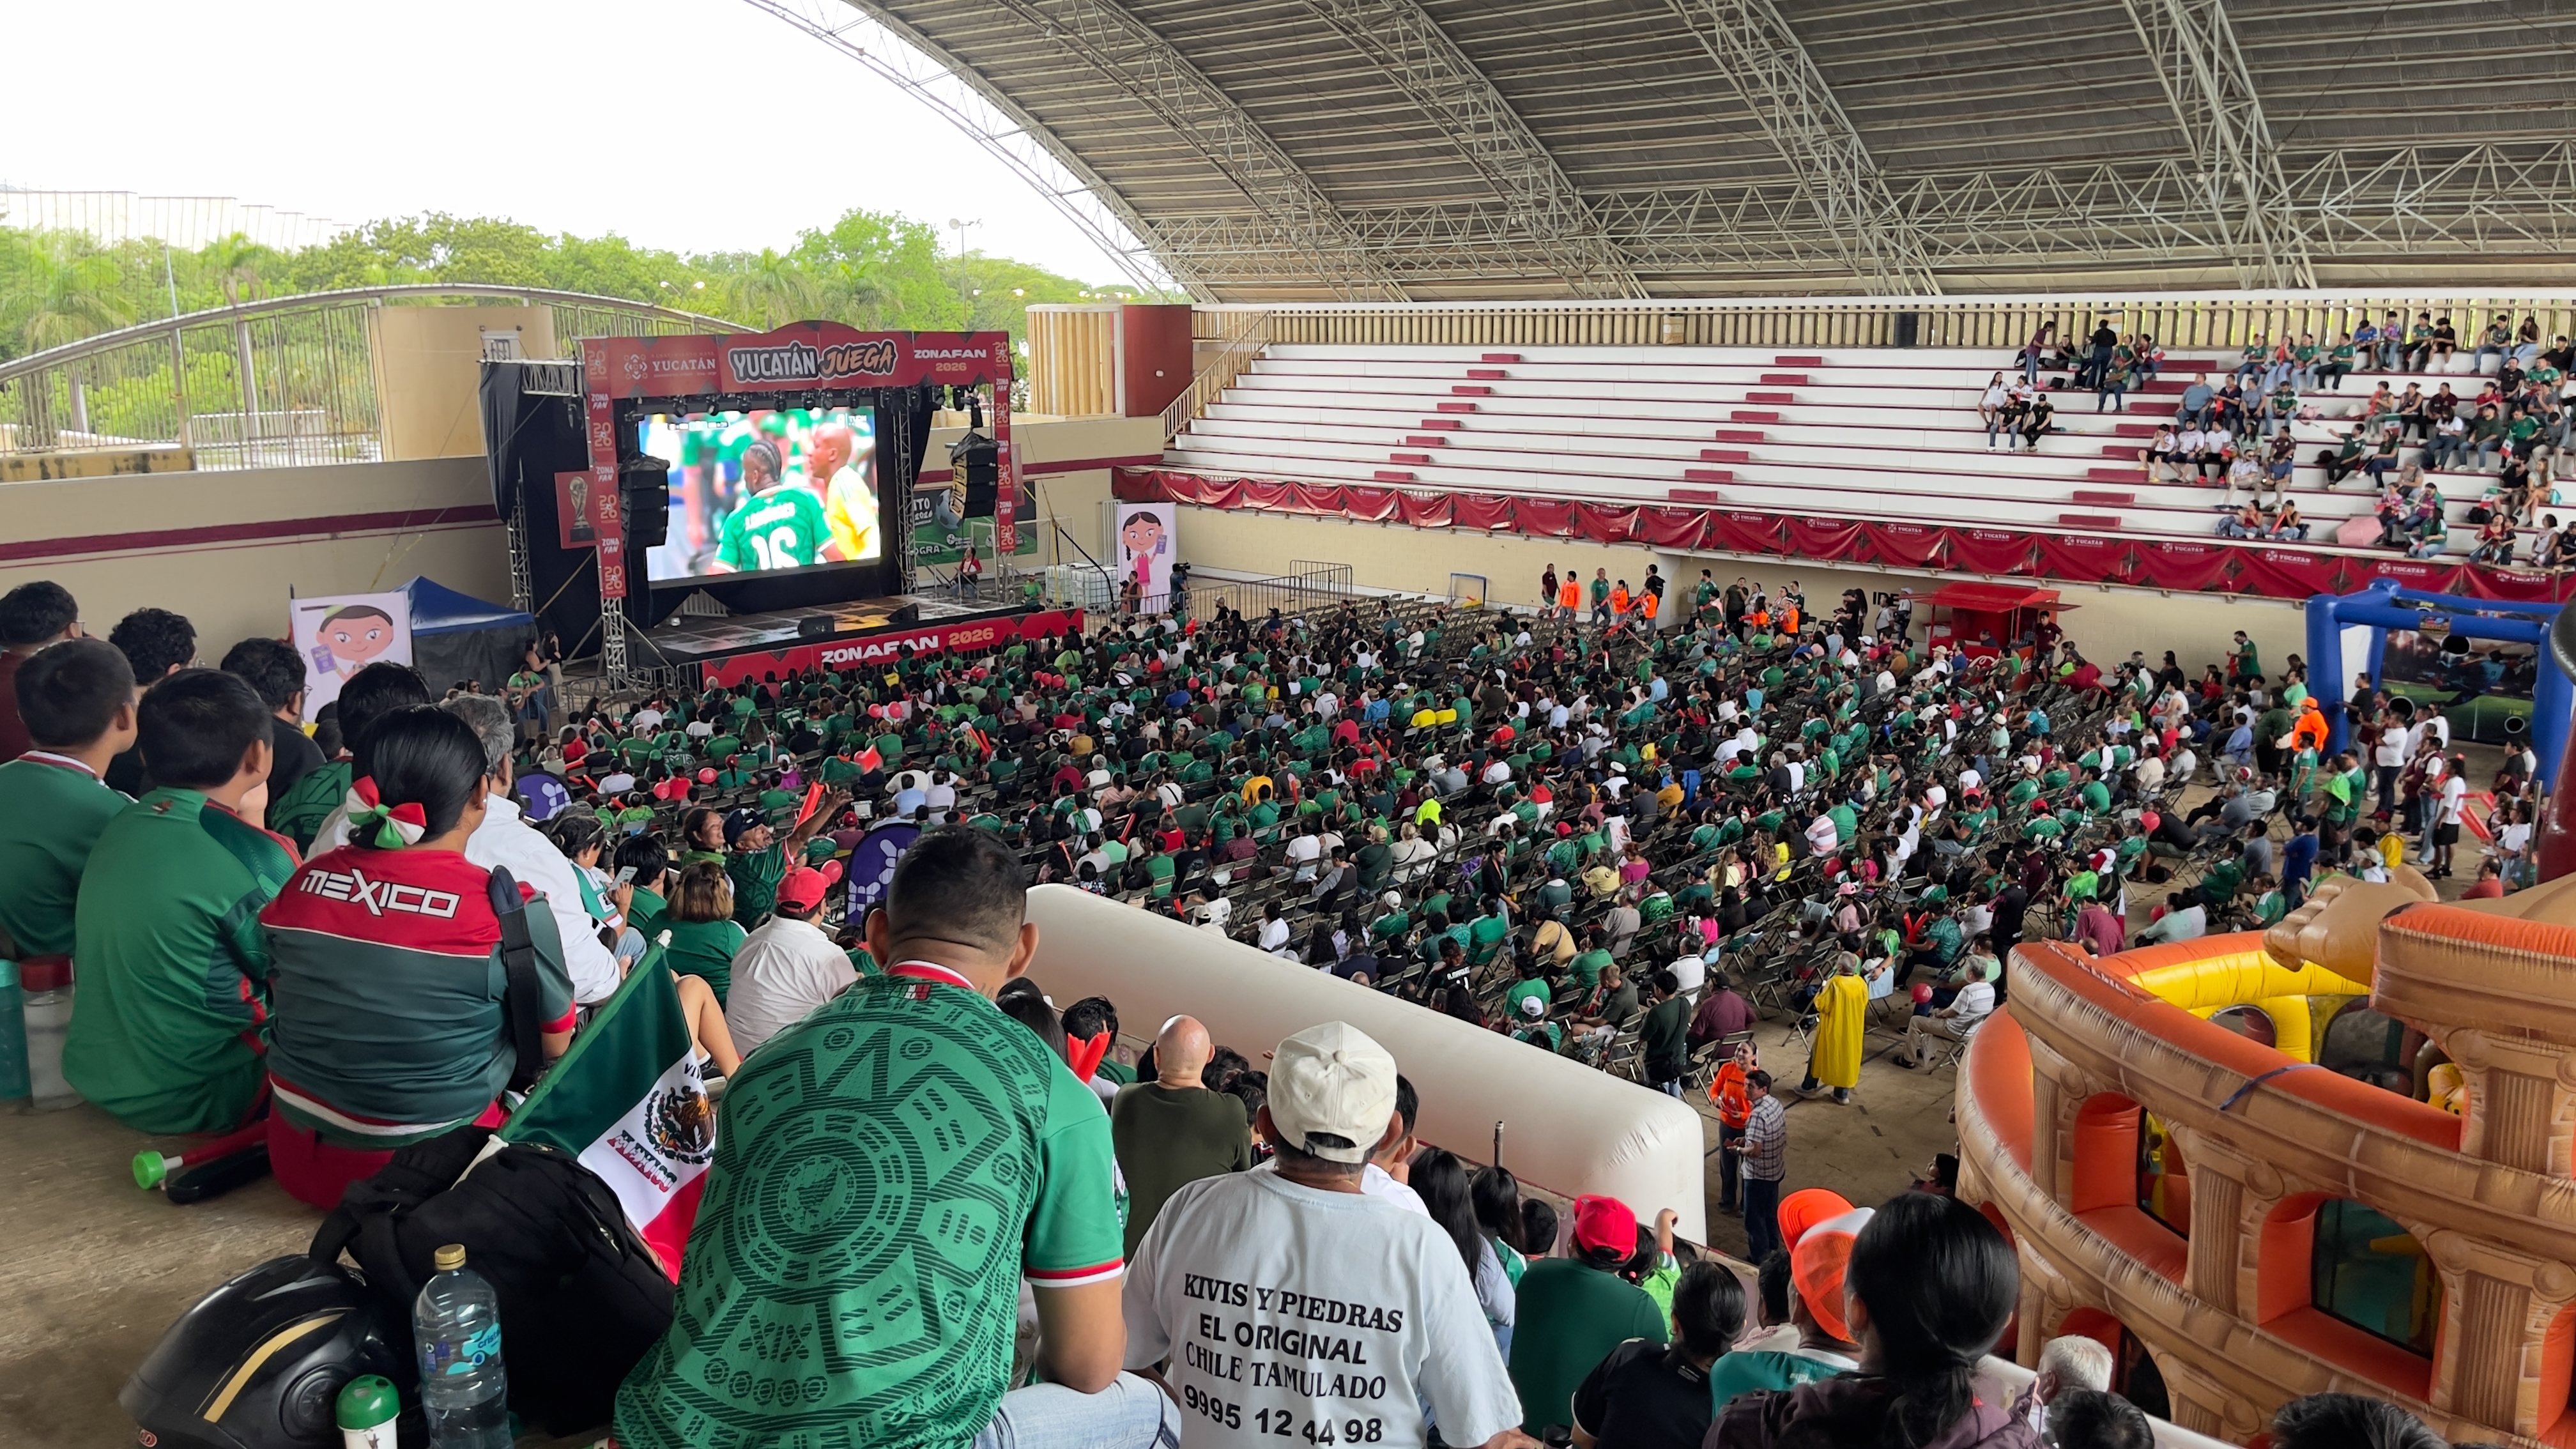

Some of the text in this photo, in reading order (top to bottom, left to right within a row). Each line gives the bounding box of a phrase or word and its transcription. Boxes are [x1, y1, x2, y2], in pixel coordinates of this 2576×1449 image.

[652, 357, 716, 371] YUCATÁN
[733, 344, 893, 378] YUCATÁN JUEGA
[914, 349, 986, 359] ZONAFAN
[935, 362, 967, 372] 2026
[591, 394, 609, 402] ZONA
[596, 466, 614, 475] ZONA
[602, 538, 619, 546] ZONA
[604, 545, 618, 554] FAN
[821, 627, 993, 664] ZONAFAN 2026
[300, 868, 461, 918] MEXICO
[1184, 1273, 1404, 1333] KIVIS Y PIEDRAS
[1200, 1312, 1367, 1365] EL ORIGINAL
[1186, 1341, 1386, 1400] CHILE TAMULADO
[1184, 1384, 1383, 1446] 9995 12 44 98
